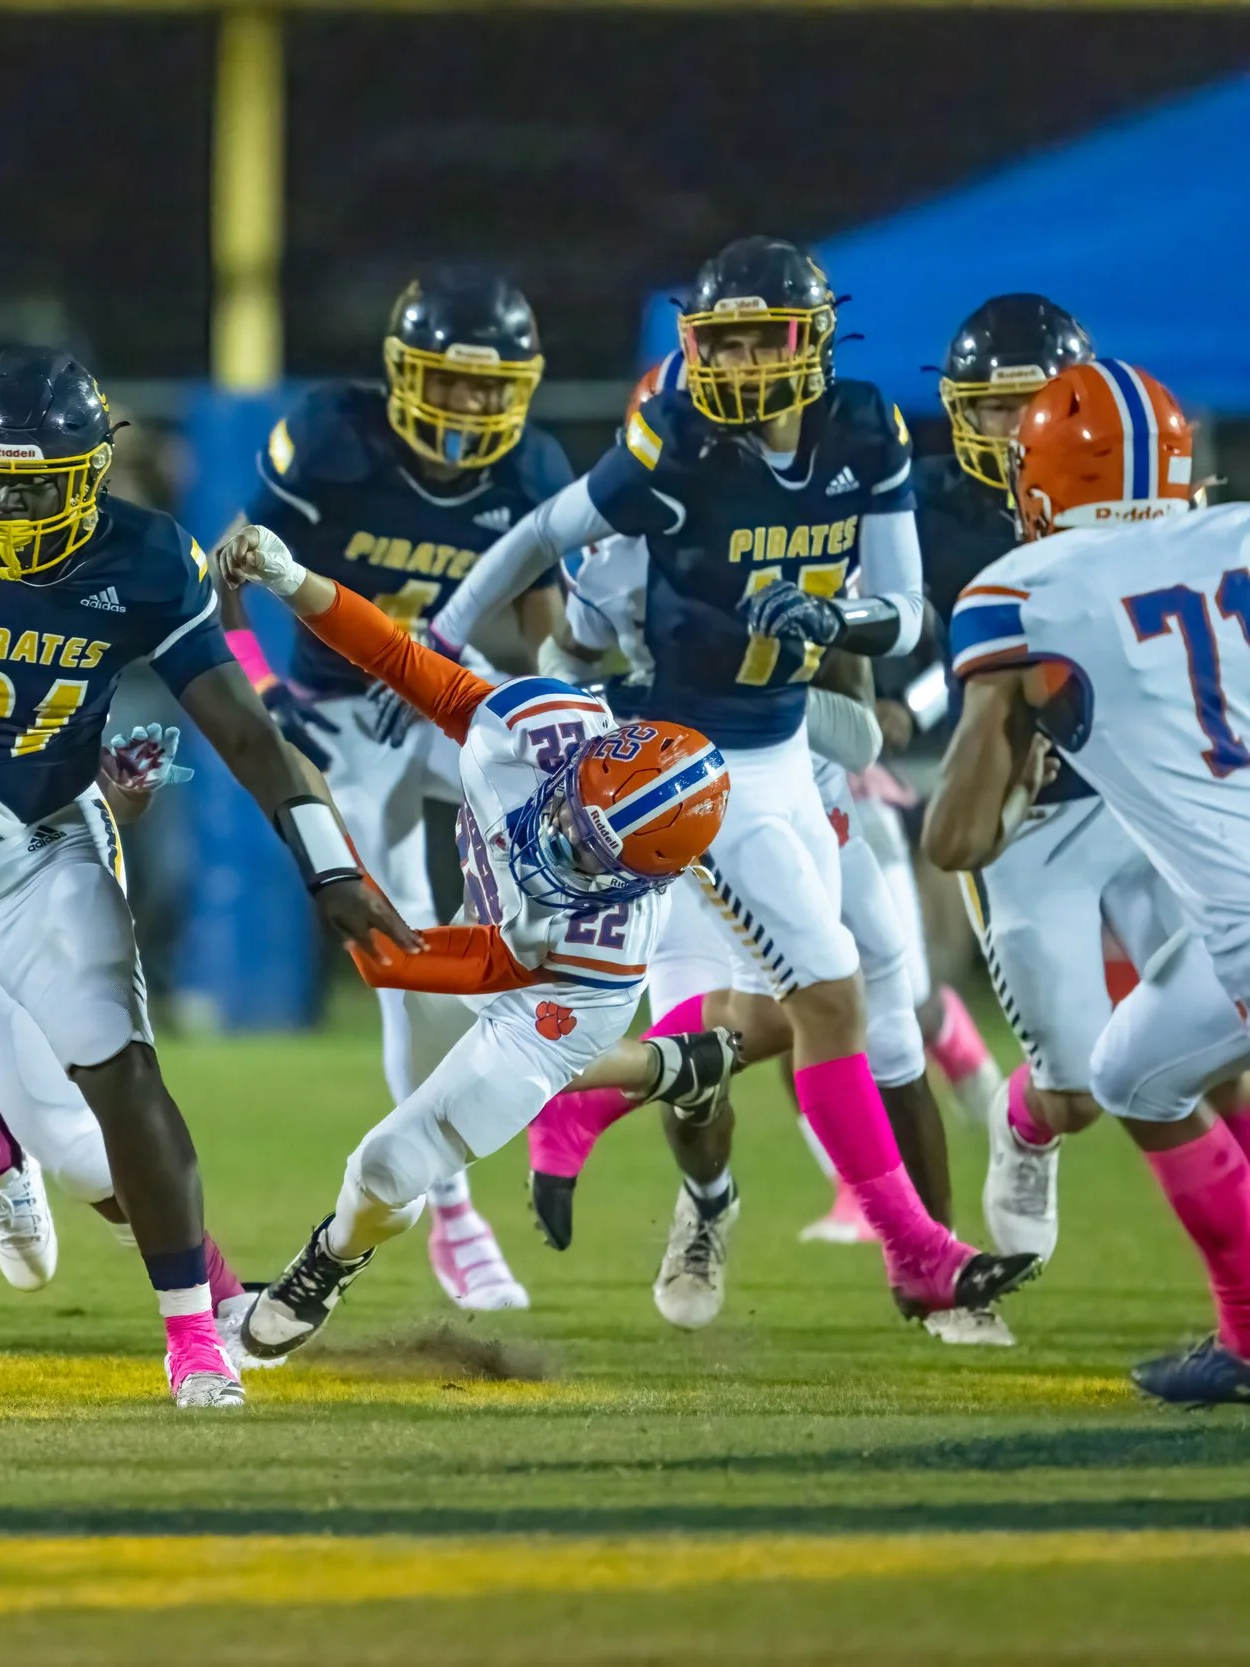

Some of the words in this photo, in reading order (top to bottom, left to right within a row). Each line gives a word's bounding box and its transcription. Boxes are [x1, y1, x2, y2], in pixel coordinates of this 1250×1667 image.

[728, 514, 858, 563] PIRATES
[80, 598, 127, 613] adidas
[590, 809, 620, 850] Riddell
